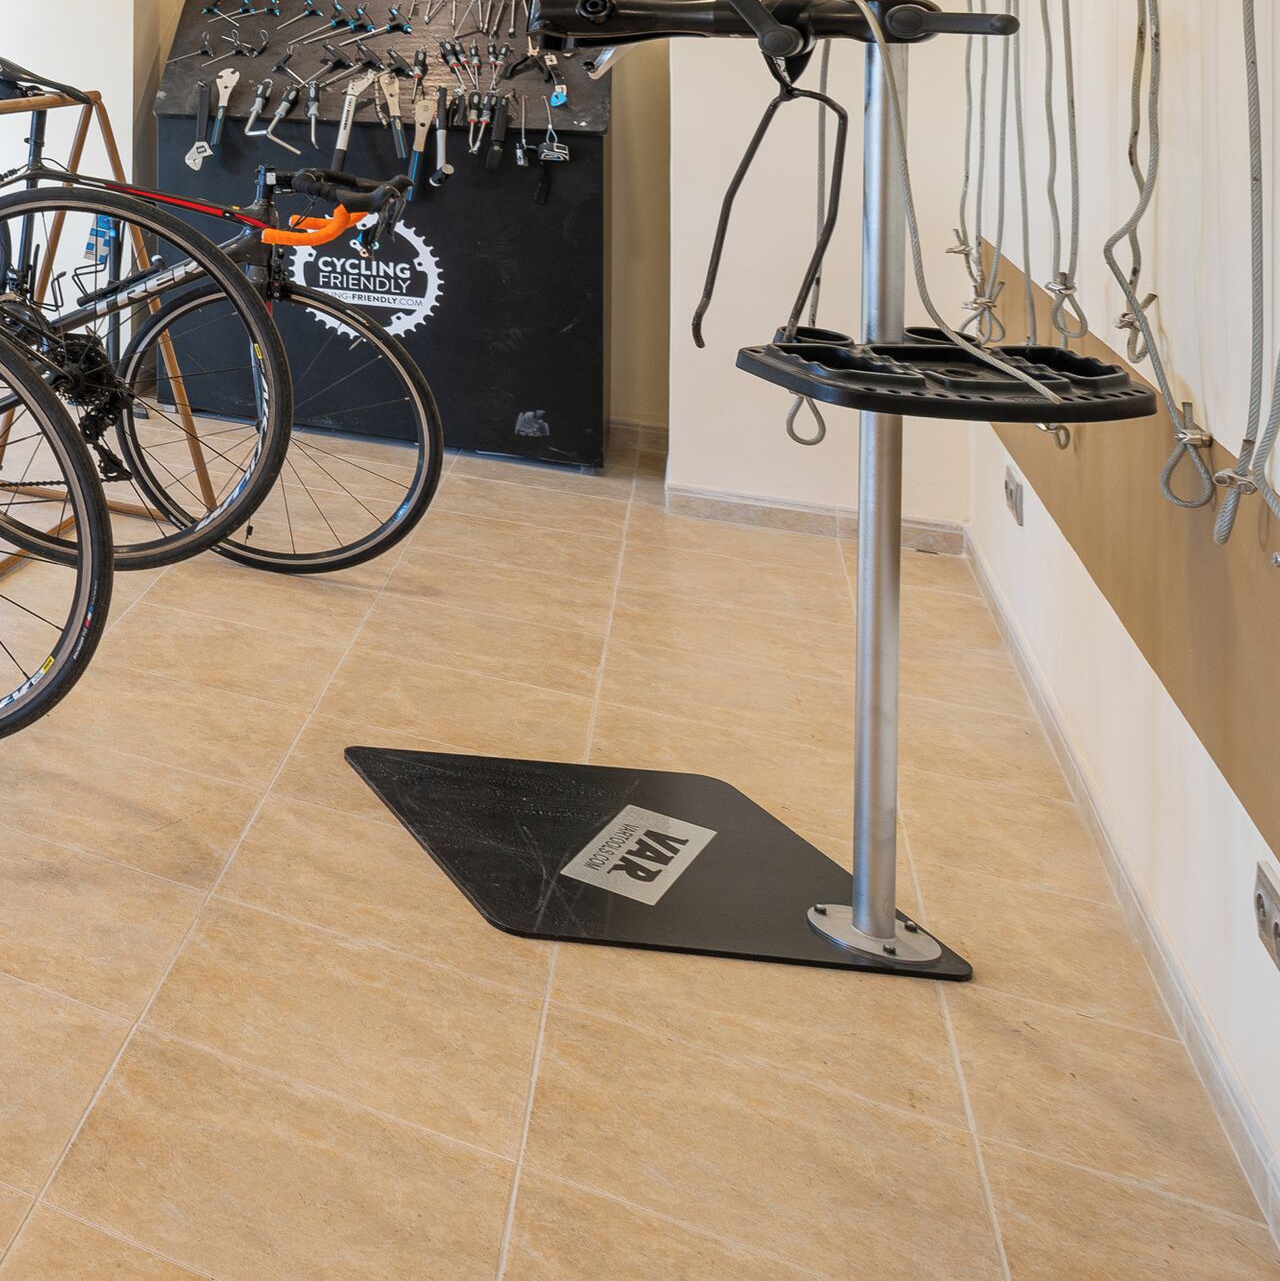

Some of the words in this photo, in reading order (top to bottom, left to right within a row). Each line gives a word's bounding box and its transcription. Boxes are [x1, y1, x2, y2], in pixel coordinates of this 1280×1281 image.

[88, 260, 201, 316] TREK
[318, 256, 411, 279] CYCLING
[319, 272, 412, 294] FRIENDLY
[583, 823, 640, 871] VARTOOLS.COM
[607, 829, 690, 883] VAR
